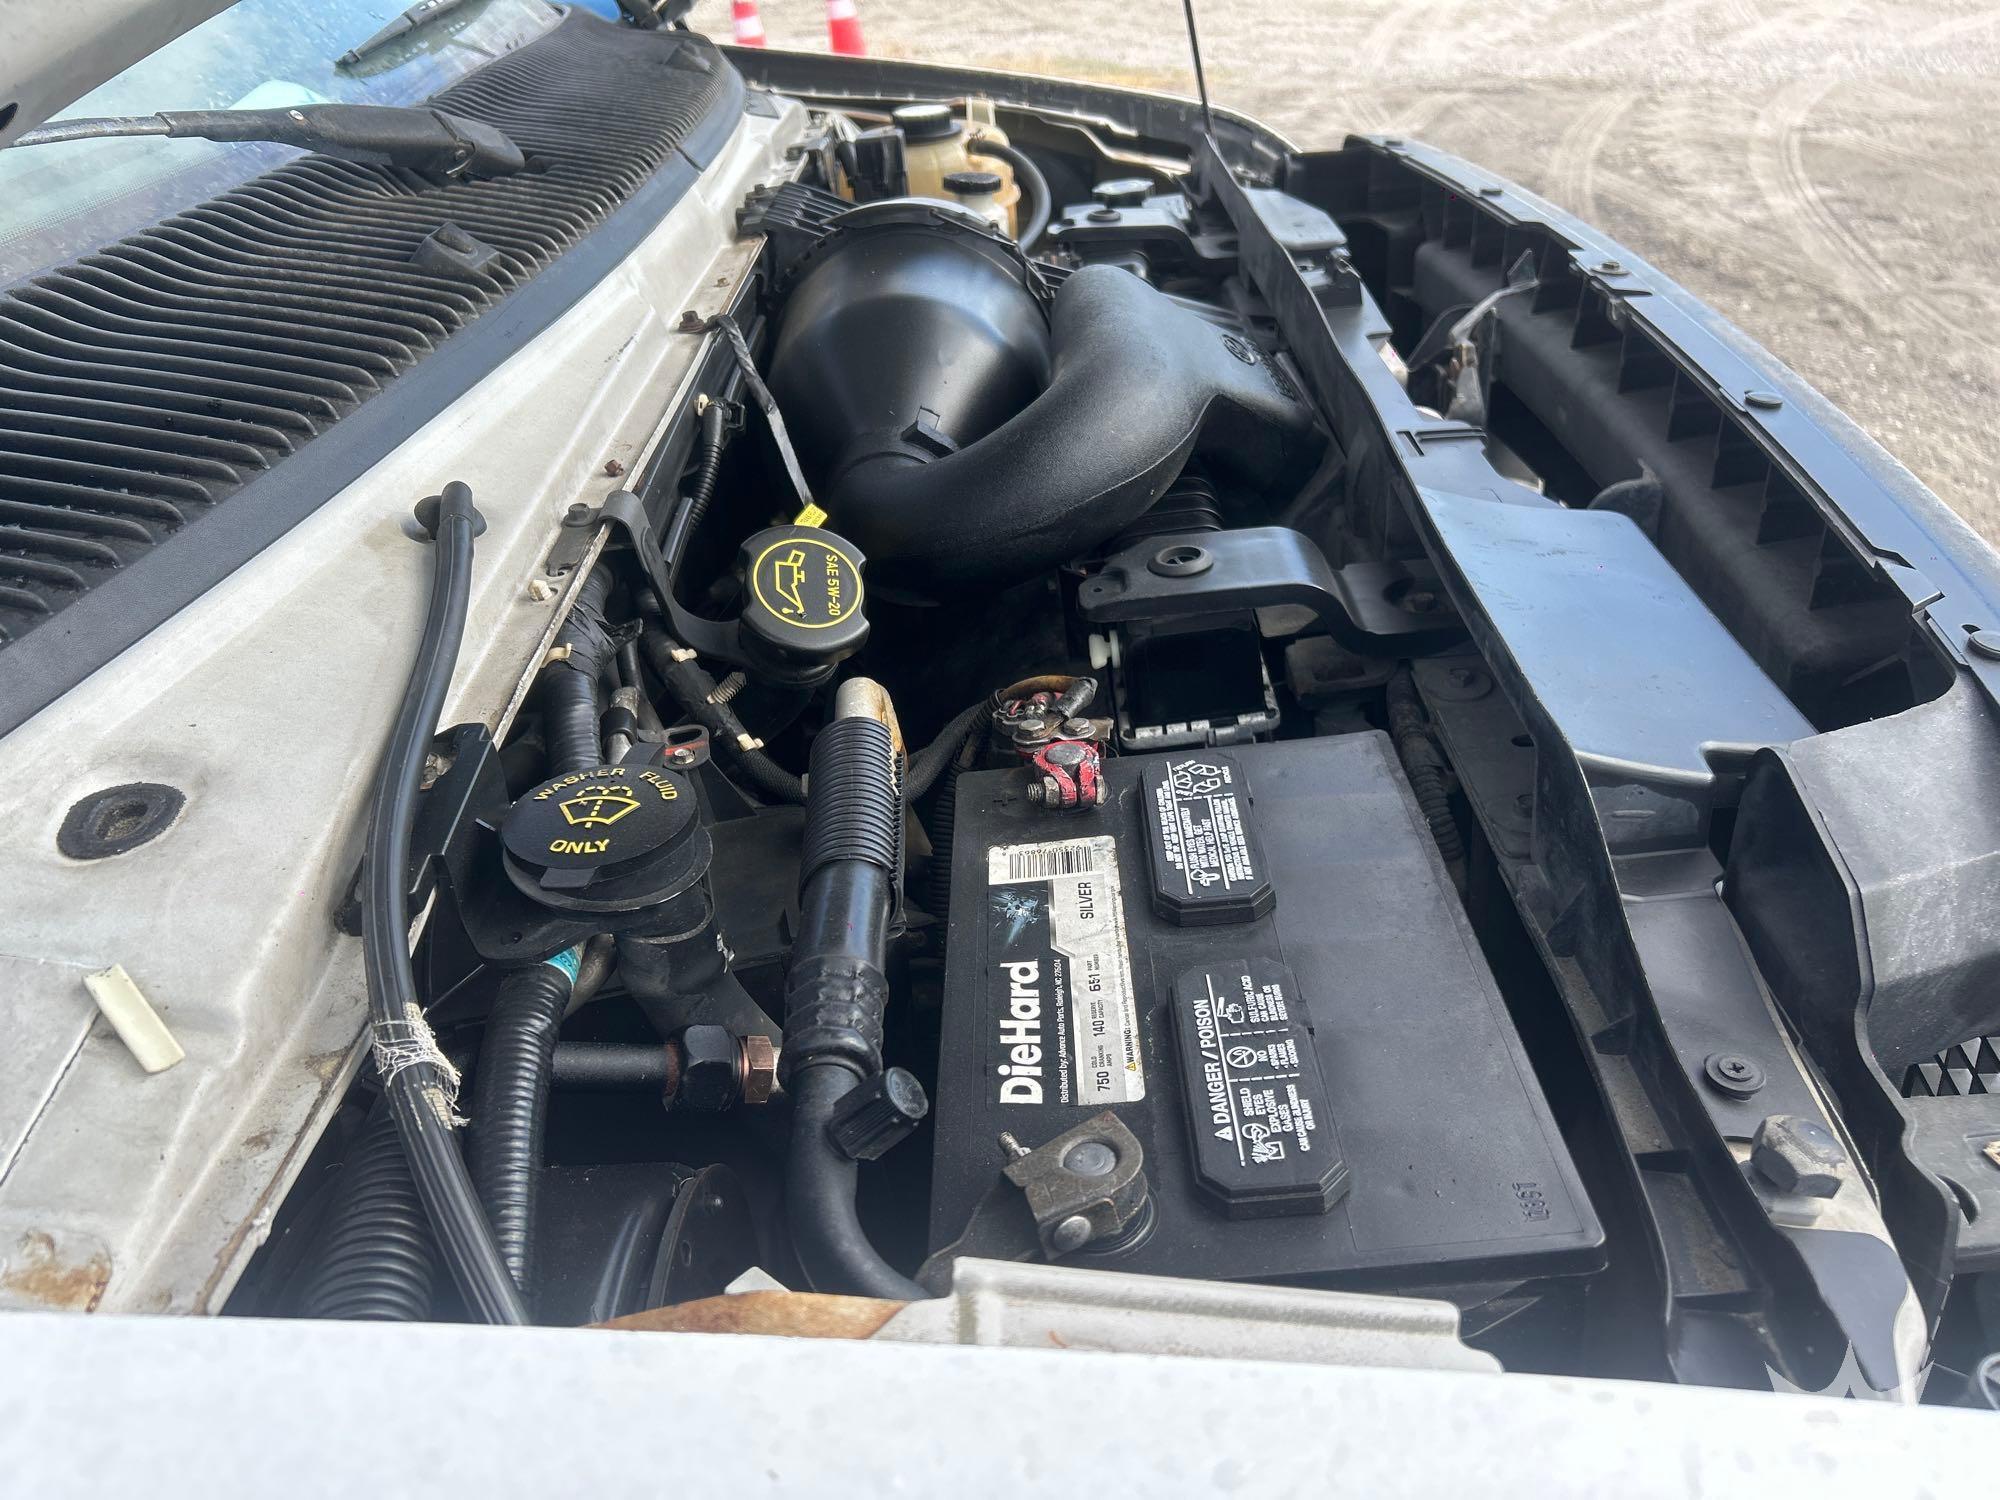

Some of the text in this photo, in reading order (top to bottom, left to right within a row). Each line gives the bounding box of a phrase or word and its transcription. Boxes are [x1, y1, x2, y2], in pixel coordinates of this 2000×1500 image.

[826, 554, 841, 616] SAE 5W-20
[533, 767, 678, 800] WASHER FLUID
[1193, 824, 1203, 836] GET
[1202, 818, 1220, 868] MEDICAL HELP FAST
[549, 839, 609, 854] ONLY
[1186, 839, 1197, 853] EYES
[1188, 852, 1199, 869] FLUSH
[1198, 855, 1209, 868] WITH
[1078, 882, 1094, 920] SILVER
[1089, 974, 1101, 992] 651
[1241, 975, 1261, 1023] SULFURIC ACID
[998, 961, 1043, 1103] DieHard
[1093, 1021, 1106, 1037] 140
[1194, 999, 1216, 1048] POISON
[1058, 1036, 1067, 1058] Advance
[1124, 1028, 1134, 1063] WARNING:
[1256, 1050, 1269, 1062] NO
[1059, 1059, 1069, 1068] by:
[1059, 1070, 1069, 1103] Distributed
[1097, 1072, 1110, 1091] 750
[1205, 1062, 1231, 1124] DANGER
[1240, 1088, 1255, 1117] SHIELD
[1253, 1094, 1266, 1115] EYES
[1263, 1089, 1282, 1133] EXPLOSIVE
[1278, 1104, 1294, 1132] GASES
